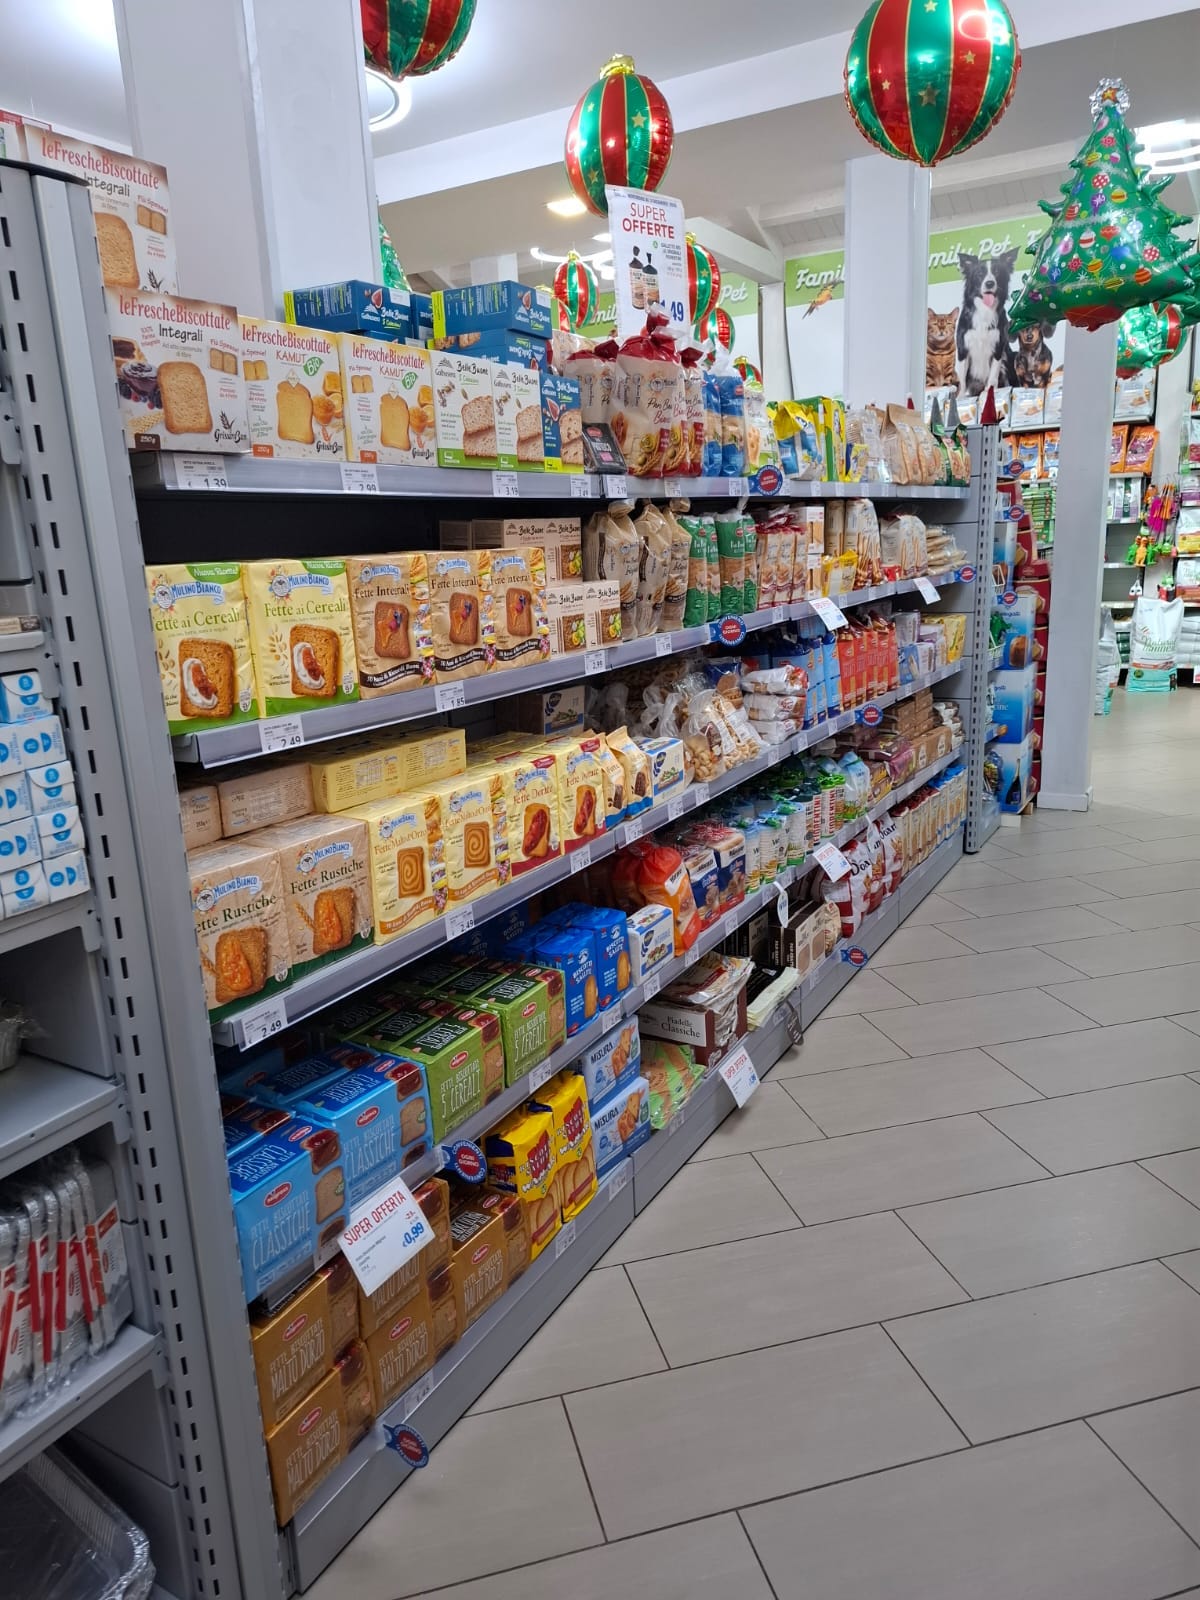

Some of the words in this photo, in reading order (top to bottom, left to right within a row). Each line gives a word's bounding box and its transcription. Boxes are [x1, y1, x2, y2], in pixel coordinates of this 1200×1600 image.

[630, 203, 667, 222] SUPER
[622, 218, 675, 239] OFFERTE
[979, 239, 1012, 256] Pet
[720, 284, 748, 303] Pet
[119, 295, 230, 330] leFrescheBiscottate
[159, 324, 203, 343] Integrali
[276, 351, 306, 364] KAMUT
[380, 367, 404, 378] KAMUT
[171, 583, 196, 597] MULINO
[197, 581, 222, 594] BIANCO
[355, 588, 374, 599] Fette
[264, 603, 293, 617] Fette
[296, 604, 305, 615] ai
[306, 598, 347, 614] Cereali
[155, 616, 179, 632] ette
[181, 618, 191, 629] ai
[194, 608, 240, 627] Cereali
[291, 875, 318, 895] Fette
[320, 858, 366, 882] Rustiche
[214, 881, 235, 899] MULINO
[235, 876, 258, 891] BIANCO
[195, 910, 218, 930] ette
[222, 894, 278, 921] Rustiche
[661, 1023, 701, 1038] Classiche
[450, 1070, 481, 1113] CEREALI
[343, 1217, 373, 1246] SUPER
[371, 1190, 406, 1224] OFFERTA
[252, 1202, 310, 1270] CLASSICHE
[272, 1354, 298, 1401] MALTO
